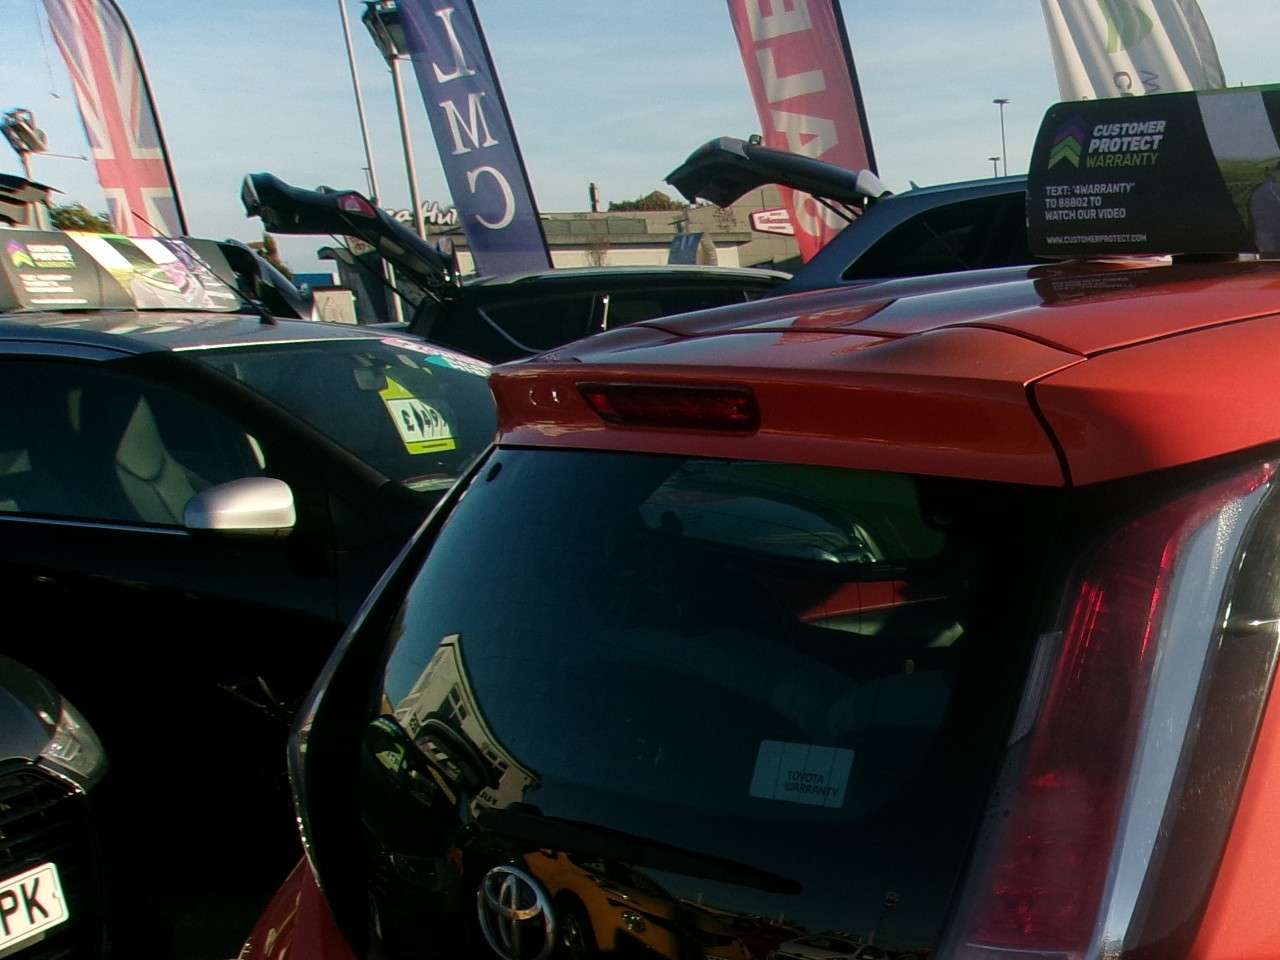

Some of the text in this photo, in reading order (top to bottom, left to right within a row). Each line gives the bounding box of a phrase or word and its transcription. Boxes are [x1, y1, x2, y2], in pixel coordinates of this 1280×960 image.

[1093, 120, 1167, 137] CUSTOMER
[1088, 134, 1164, 153] PROTECT
[1086, 151, 1160, 168] WARRANTY
[1046, 186, 1071, 196] TEXT:
[1044, 198, 1057, 208] TO
[1089, 196, 1102, 206] TO
[1045, 207, 1127, 221] WATCH OUR VIDEO
[787, 769, 825, 785] TOYOTA
[783, 781, 840, 798] WARRANTY
